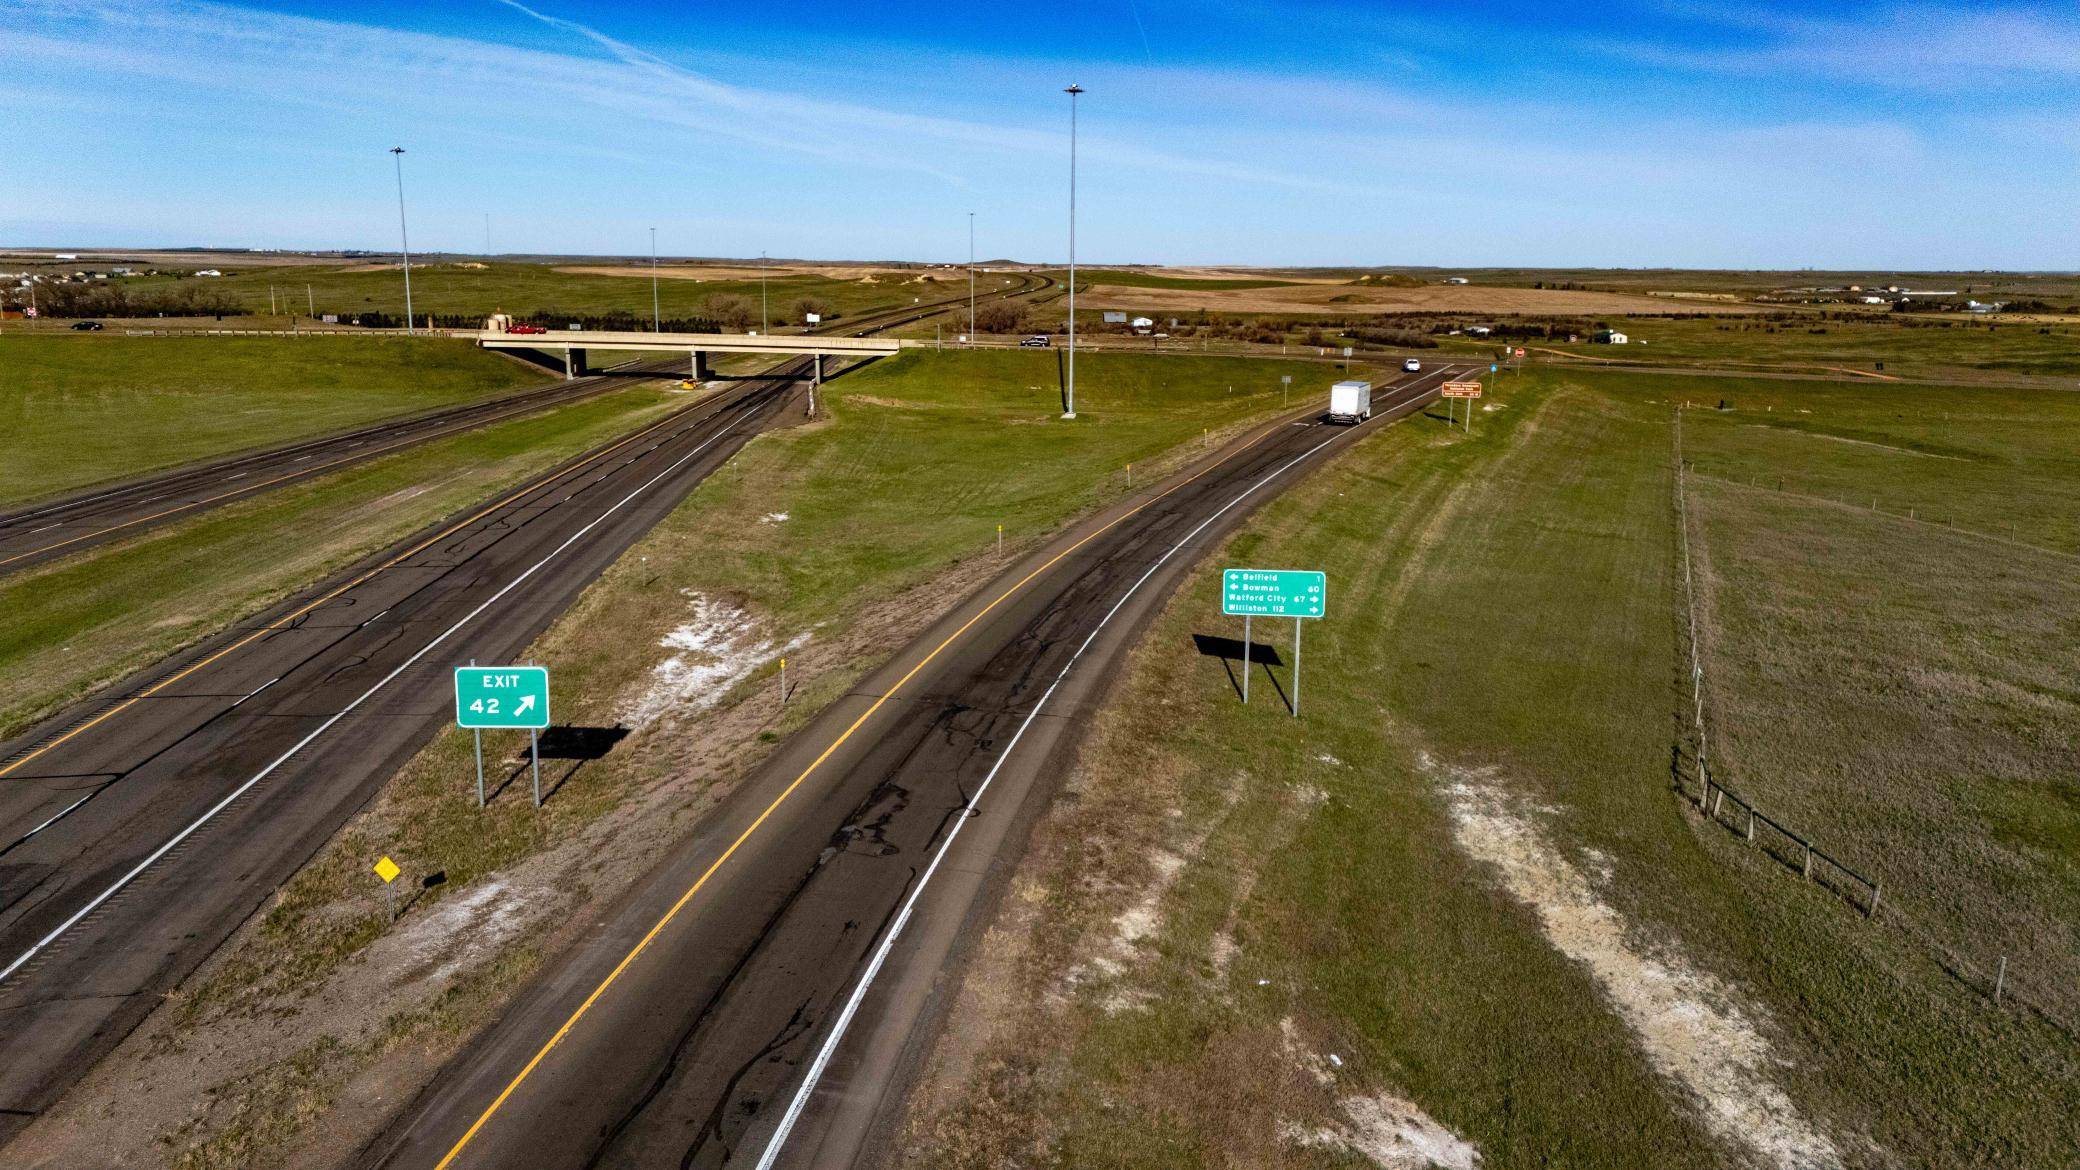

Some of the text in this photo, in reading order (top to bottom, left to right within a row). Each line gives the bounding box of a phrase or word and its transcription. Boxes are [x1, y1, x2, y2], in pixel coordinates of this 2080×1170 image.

[1242, 573, 1278, 581] Belfield
[1243, 583, 1279, 591] Bowman
[1267, 595, 1286, 603] City
[1294, 595, 1306, 603] 67
[1229, 604, 1285, 613] Williston 112
[483, 675, 520, 688] EXIT
[469, 698, 500, 714] 42
